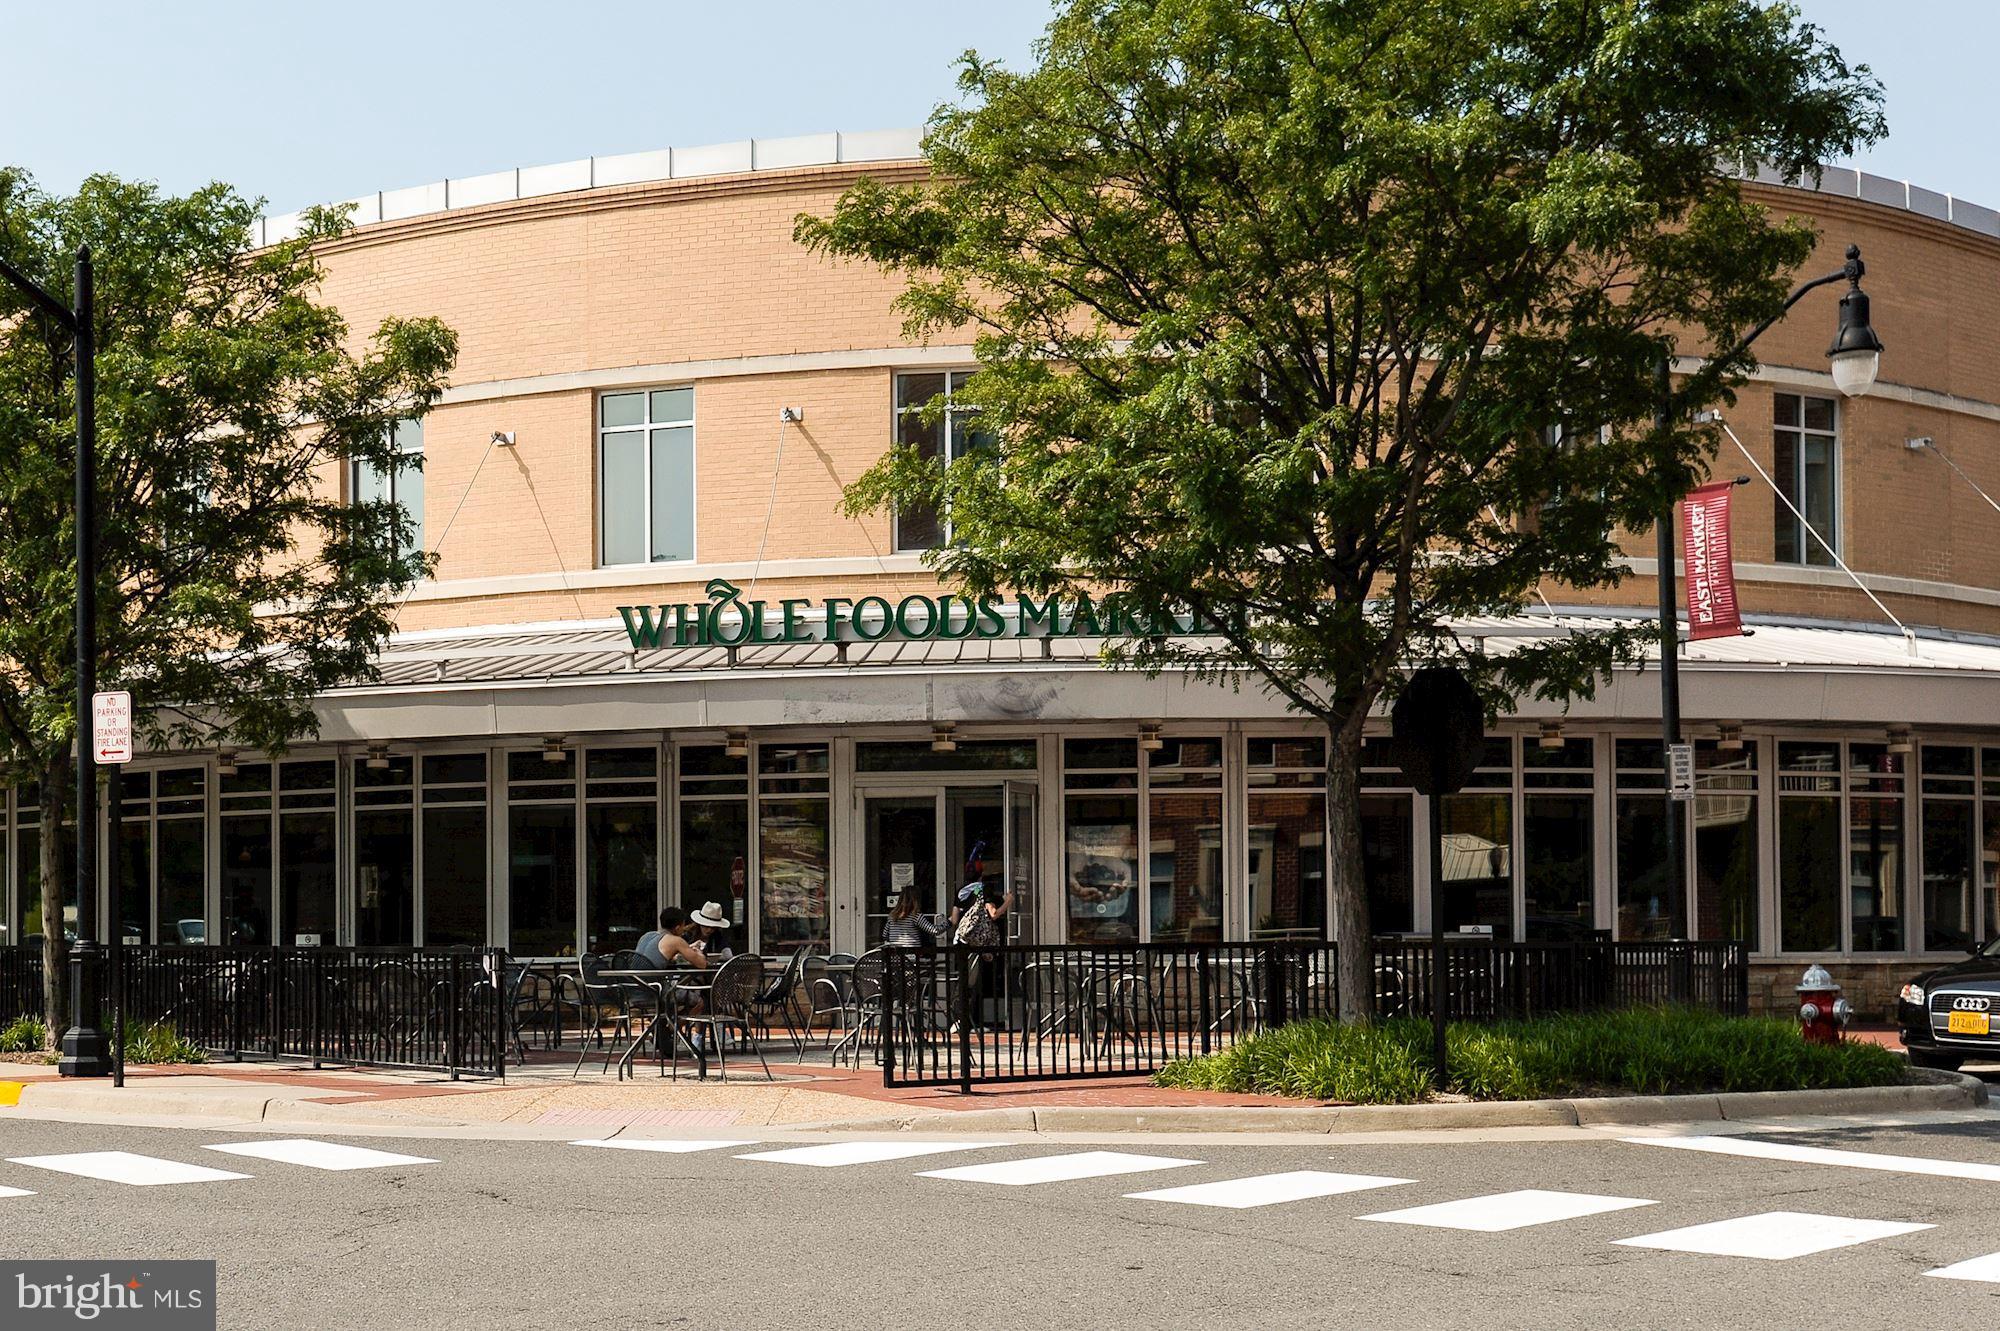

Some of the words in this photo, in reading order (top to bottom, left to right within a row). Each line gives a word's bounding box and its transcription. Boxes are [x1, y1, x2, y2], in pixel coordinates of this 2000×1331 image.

[1692, 504, 1706, 574] MARKET
[1696, 579, 1713, 622] EAST
[616, 578, 814, 648] WHOLE
[822, 594, 1007, 641] FOODS
[1015, 591, 1248, 637] MARK
[107, 697, 116, 706] NO
[97, 708, 126, 717] PARKING
[107, 718, 116, 726] OR
[97, 728, 128, 737] STANDING
[97, 739, 110, 747] FIRE
[112, 737, 127, 746] LANE
